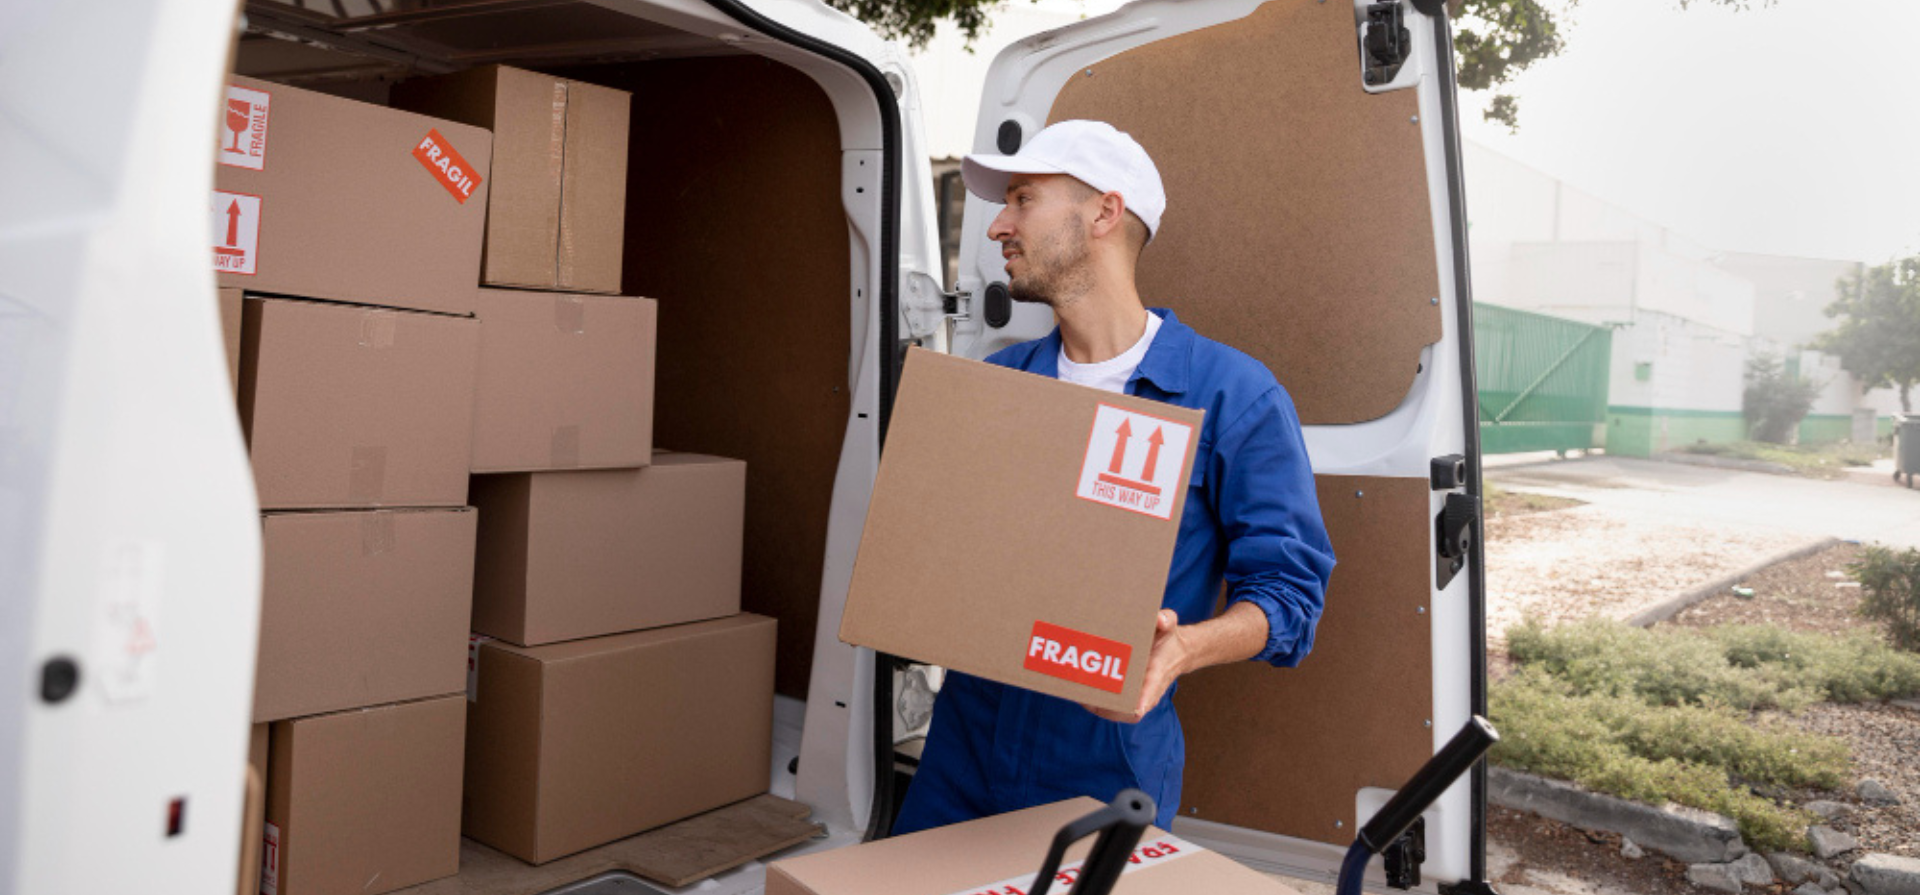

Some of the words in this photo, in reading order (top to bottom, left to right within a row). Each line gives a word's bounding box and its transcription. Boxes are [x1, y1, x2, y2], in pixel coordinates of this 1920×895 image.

[250, 104, 266, 157] FRAGILE
[419, 136, 473, 197] FRAGIL
[232, 257, 246, 269] UP
[1092, 481, 1116, 500] THIS
[1118, 487, 1143, 506] WAY
[1144, 495, 1161, 510] UP
[1029, 636, 1124, 681] FRAGIL
